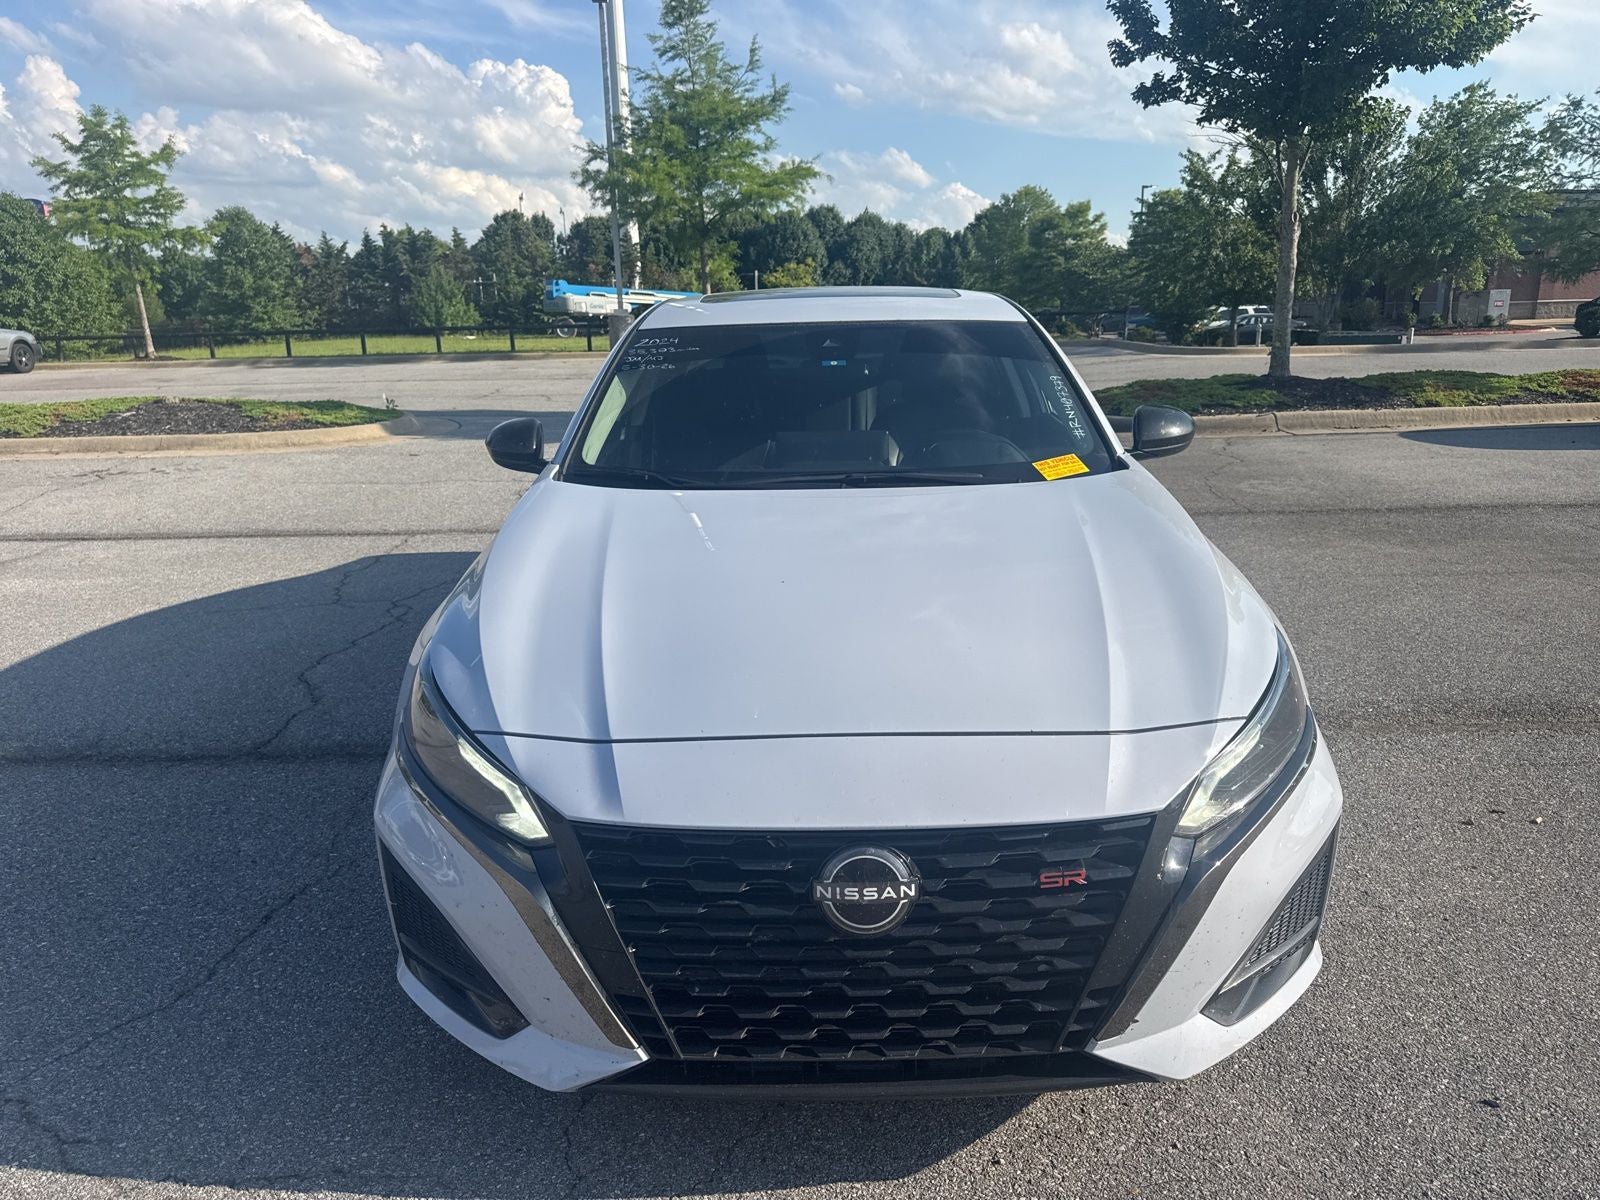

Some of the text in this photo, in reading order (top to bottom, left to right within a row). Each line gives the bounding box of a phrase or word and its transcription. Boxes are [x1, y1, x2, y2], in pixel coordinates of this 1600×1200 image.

[634, 337, 679, 347] 2024
[1051, 455, 1077, 465] VEHICLE
[1040, 868, 1087, 889] SR
[815, 883, 916, 901] NISSAN
